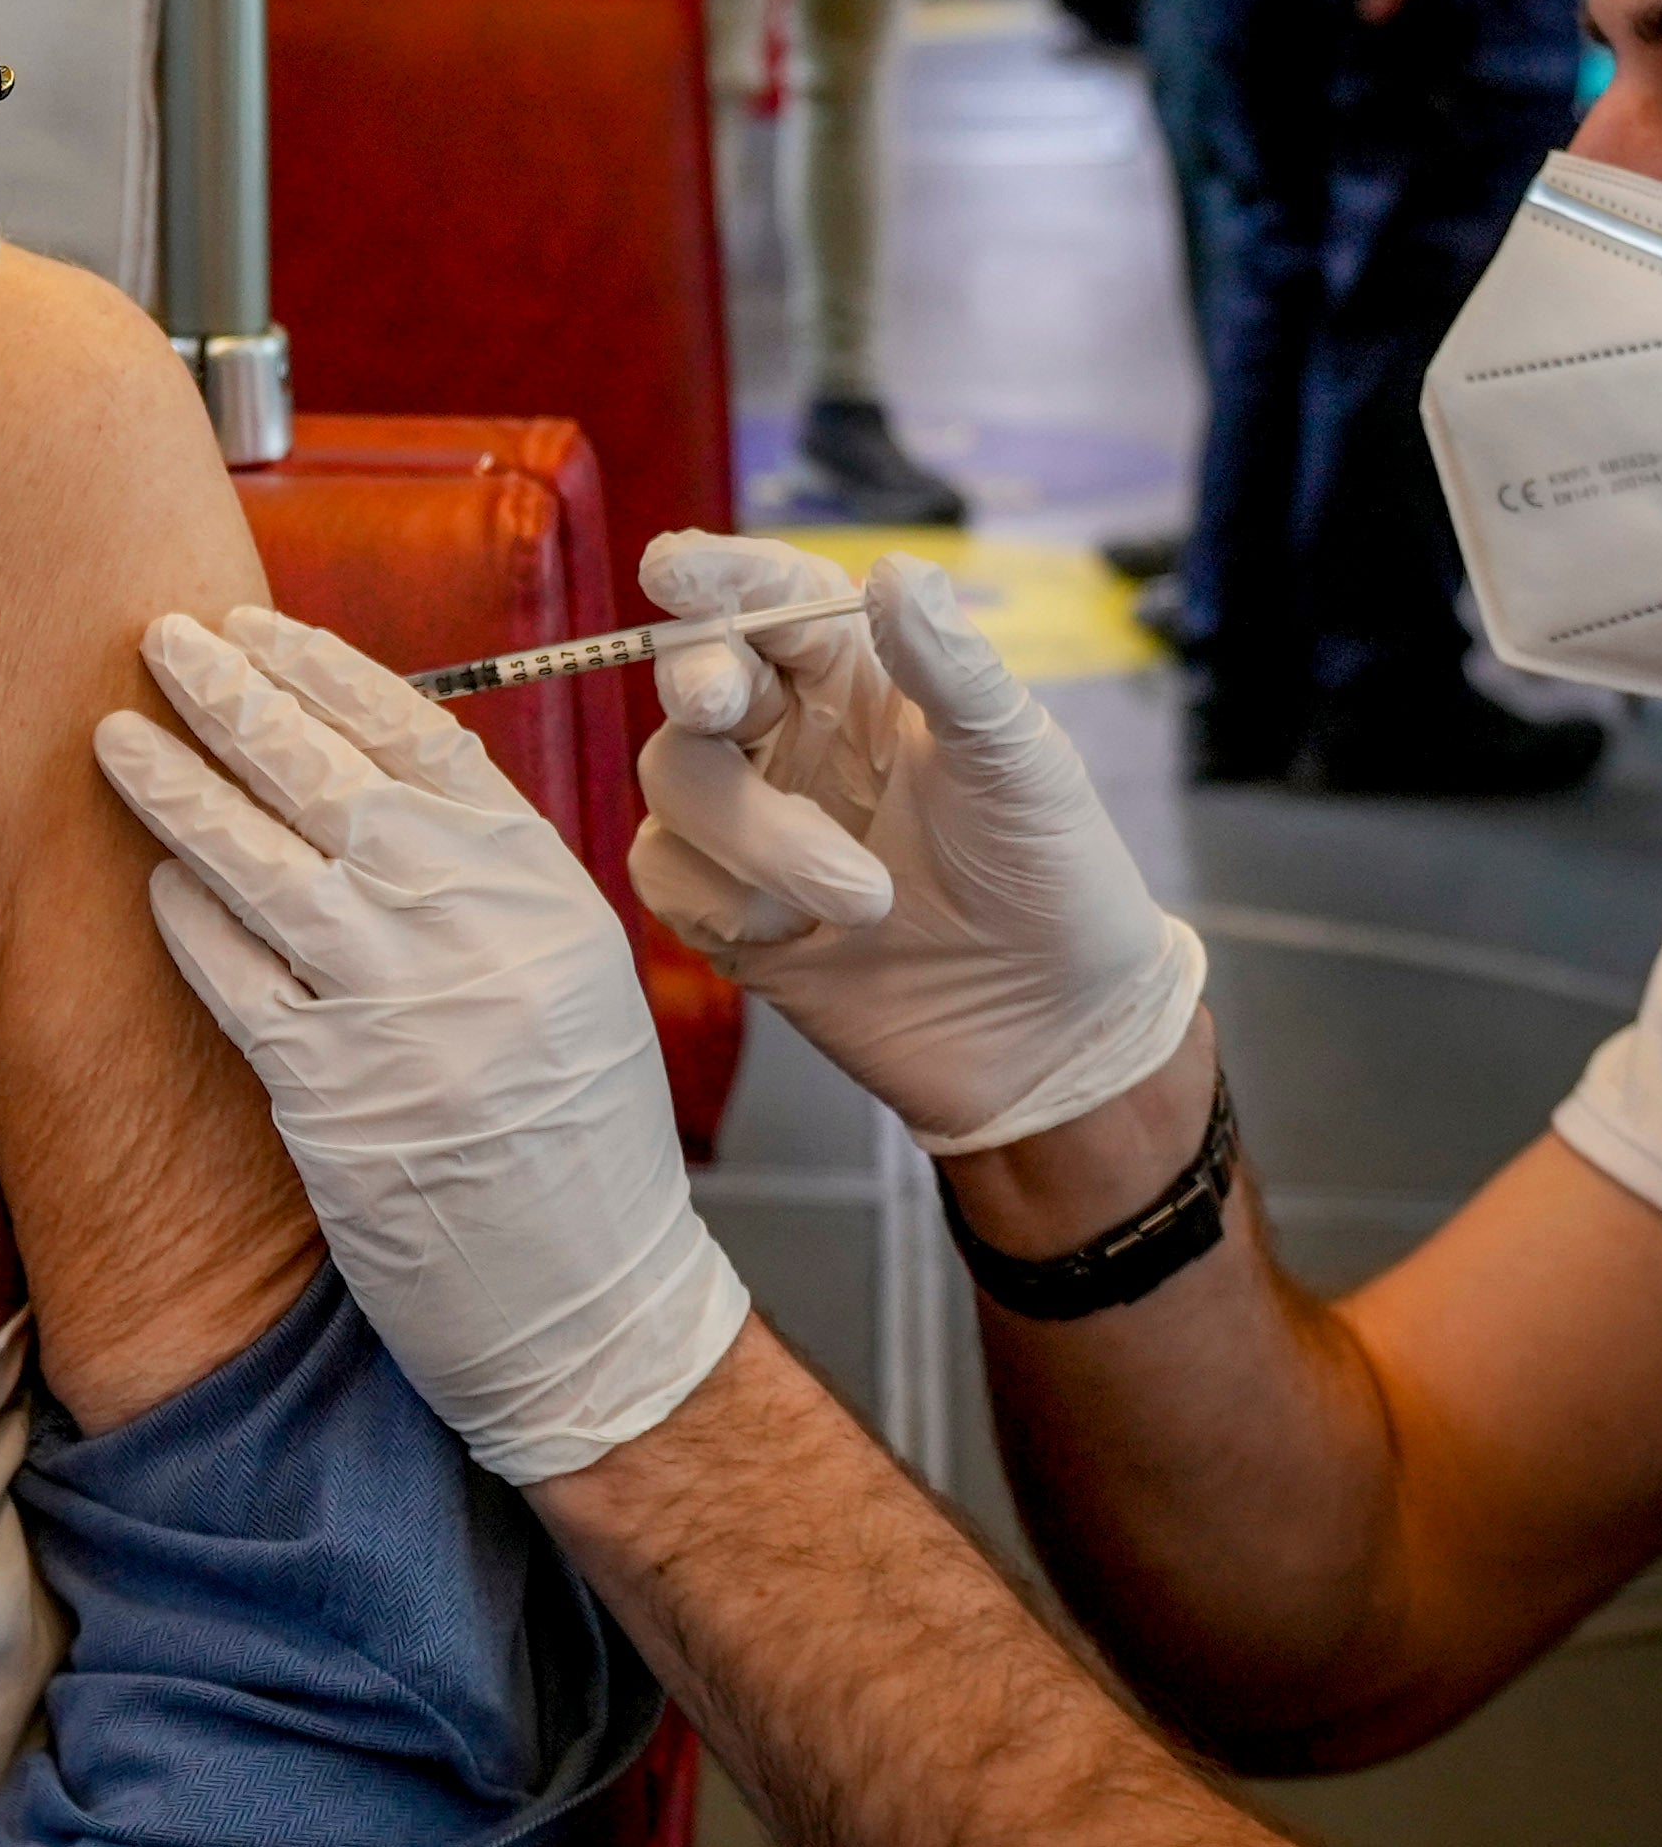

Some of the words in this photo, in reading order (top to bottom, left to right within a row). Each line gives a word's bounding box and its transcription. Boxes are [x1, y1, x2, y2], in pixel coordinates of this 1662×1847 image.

[610, 640, 630, 662] 0.9
[637, 630, 656, 656] 1ml
[535, 655, 553, 676] 0.6
[560, 651, 579, 672] 0.7
[585, 645, 604, 668] 0.8
[510, 660, 528, 682] 0.5
